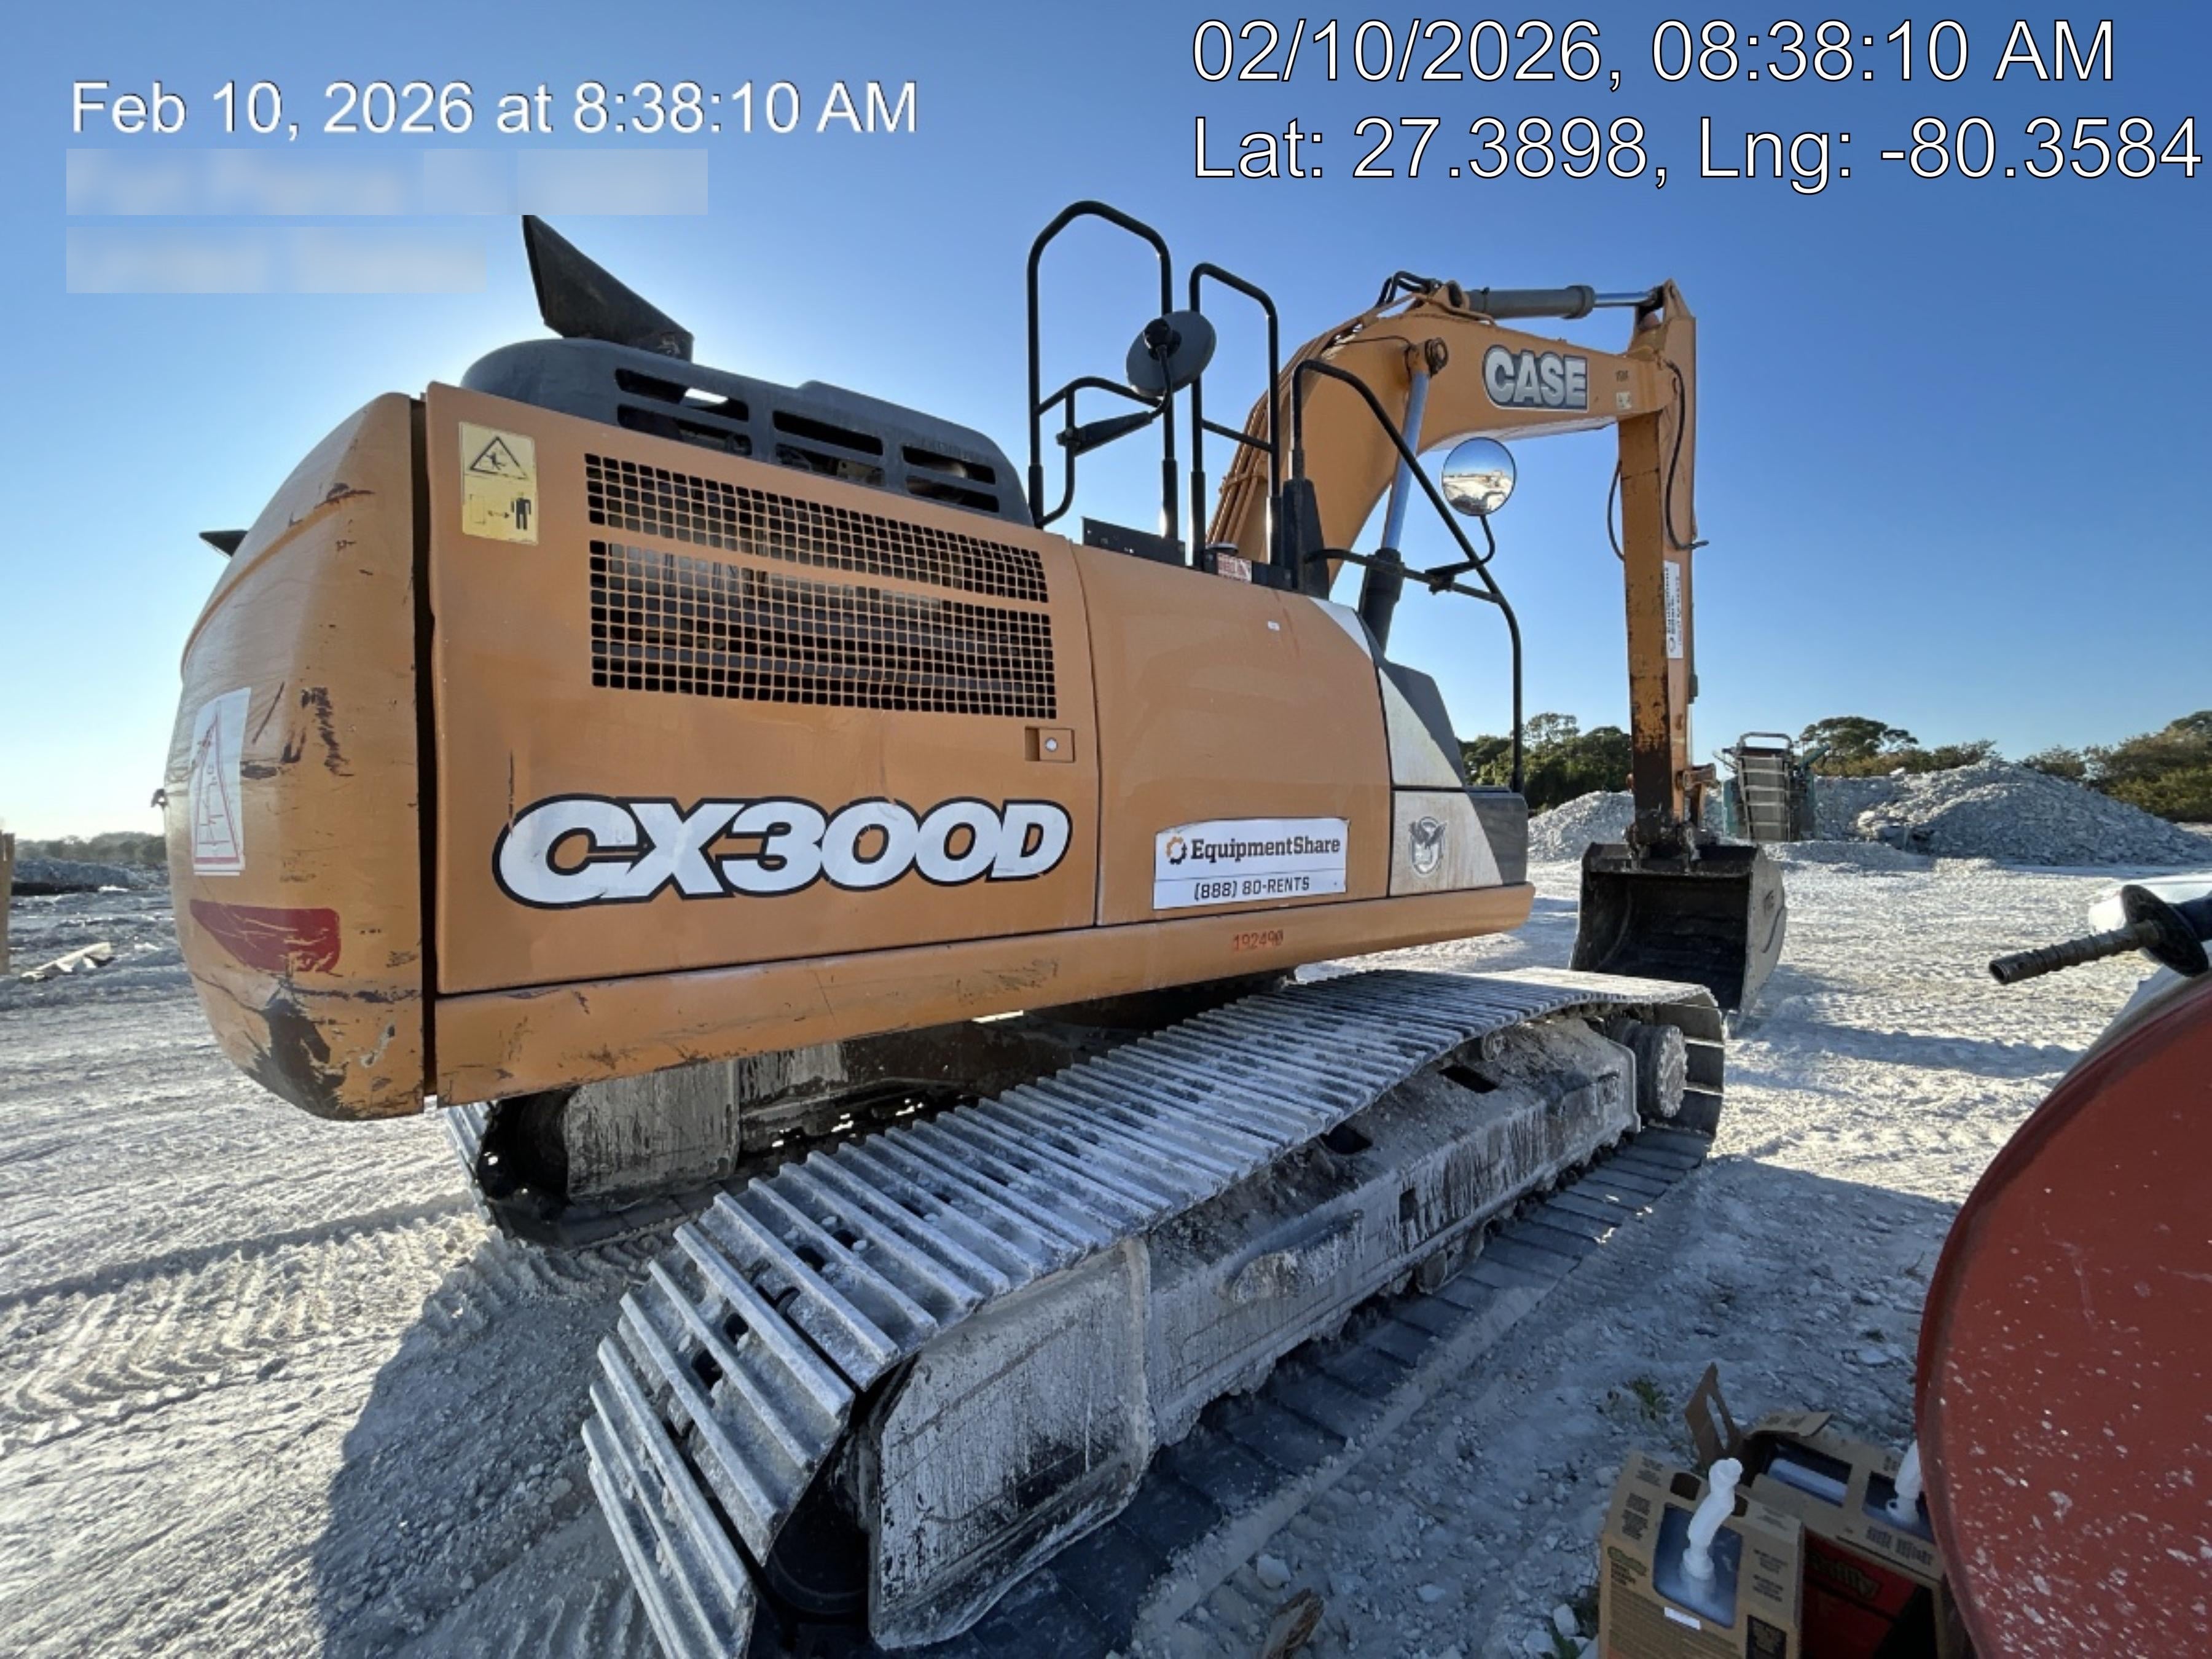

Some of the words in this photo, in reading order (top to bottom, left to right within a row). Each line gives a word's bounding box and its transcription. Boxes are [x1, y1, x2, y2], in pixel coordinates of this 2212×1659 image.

[1483, 345, 1588, 409] CASE
[493, 794, 1073, 908] CX300D
[1190, 836, 1341, 863] EquipmentShare
[1194, 880, 1237, 901] (888)
[1242, 877, 1310, 895] 80-RENTS
